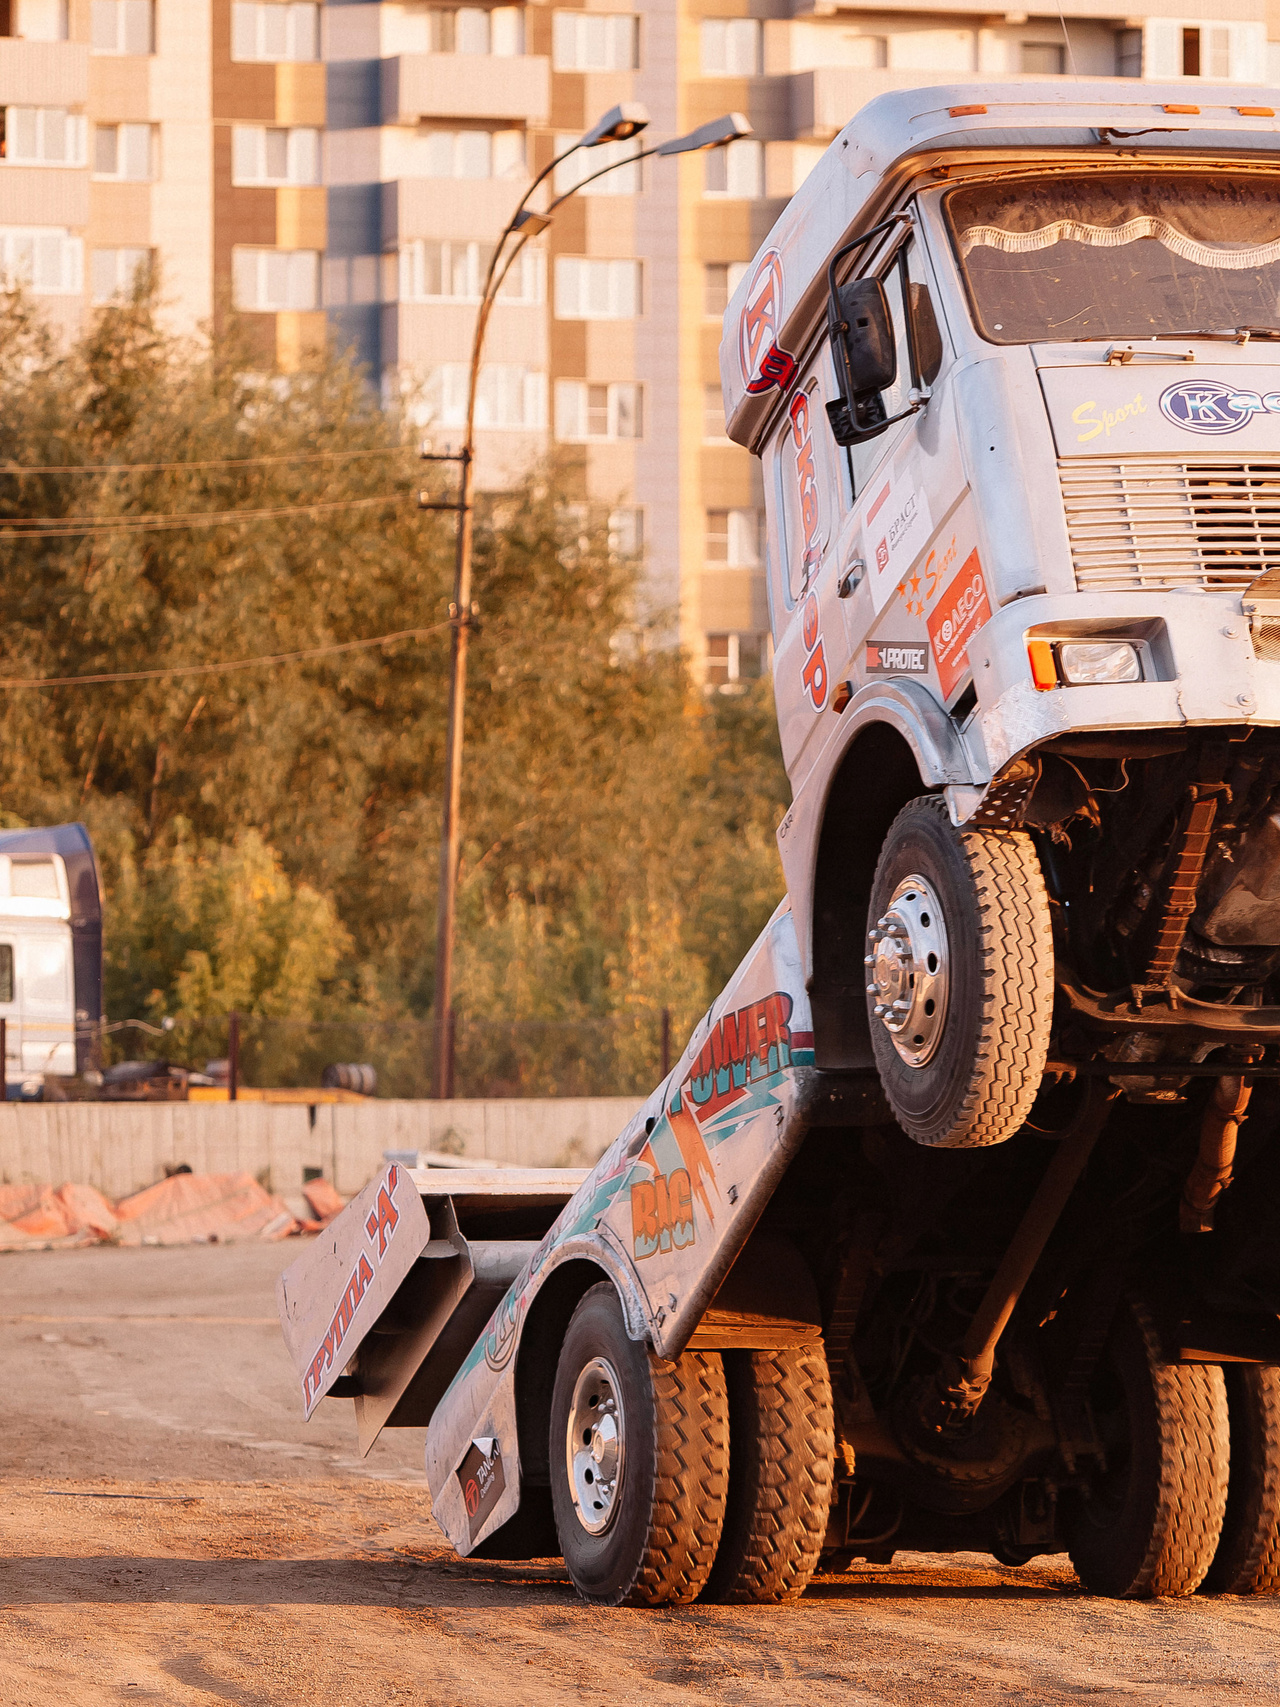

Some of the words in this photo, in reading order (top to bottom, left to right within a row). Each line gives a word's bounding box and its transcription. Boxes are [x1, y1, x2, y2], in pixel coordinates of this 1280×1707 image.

[1072, 392, 1148, 442] Sport
[924, 533, 957, 600] Sport
[933, 574, 983, 656] КОЛЕСО
[631, 1168, 696, 1262] BIG
[304, 1252, 374, 1412] ГРУППА
